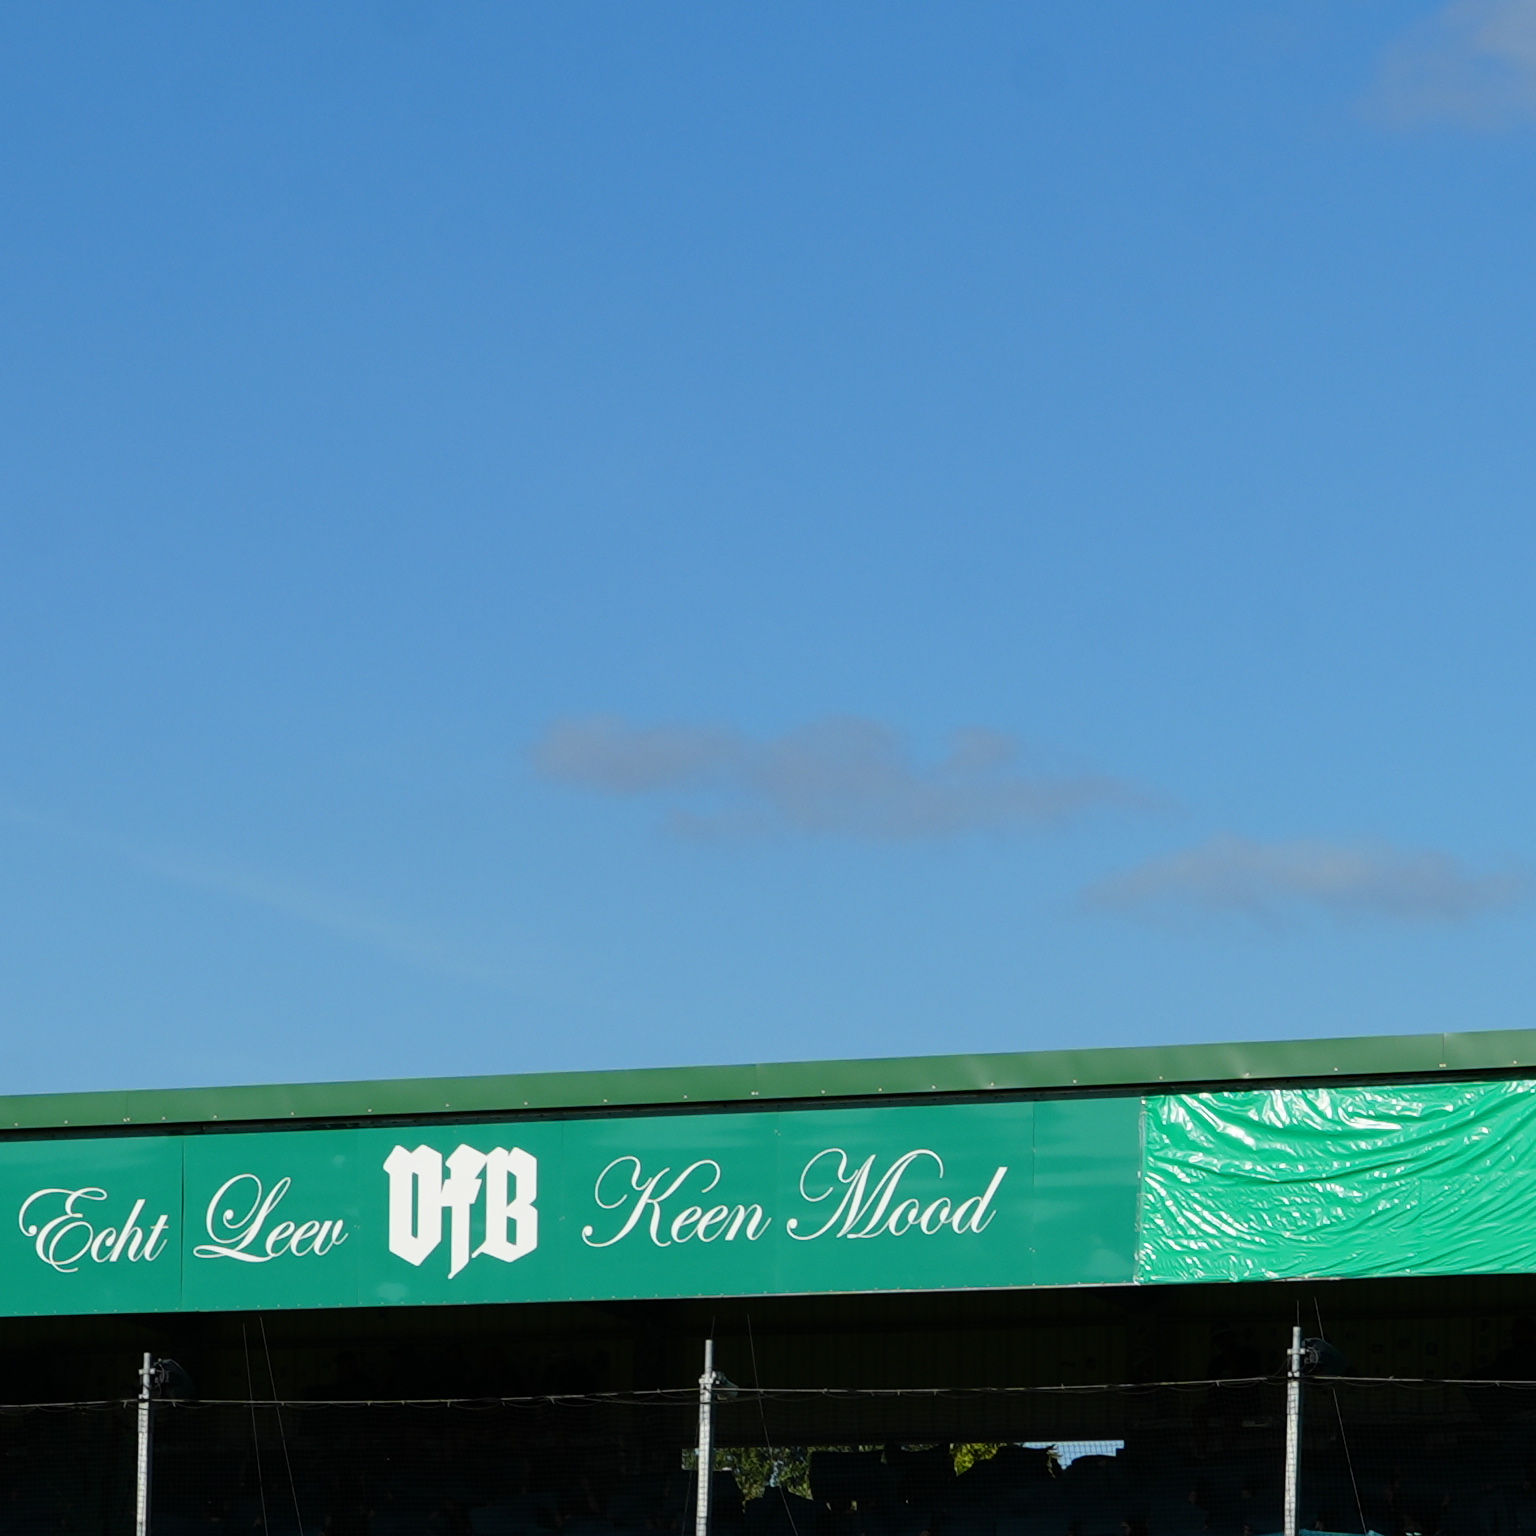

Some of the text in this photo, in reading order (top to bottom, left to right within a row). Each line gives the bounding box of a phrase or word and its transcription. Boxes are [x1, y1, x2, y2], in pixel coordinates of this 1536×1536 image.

[19, 1143, 1008, 1279] Echt Leev VfB Keen Mood
